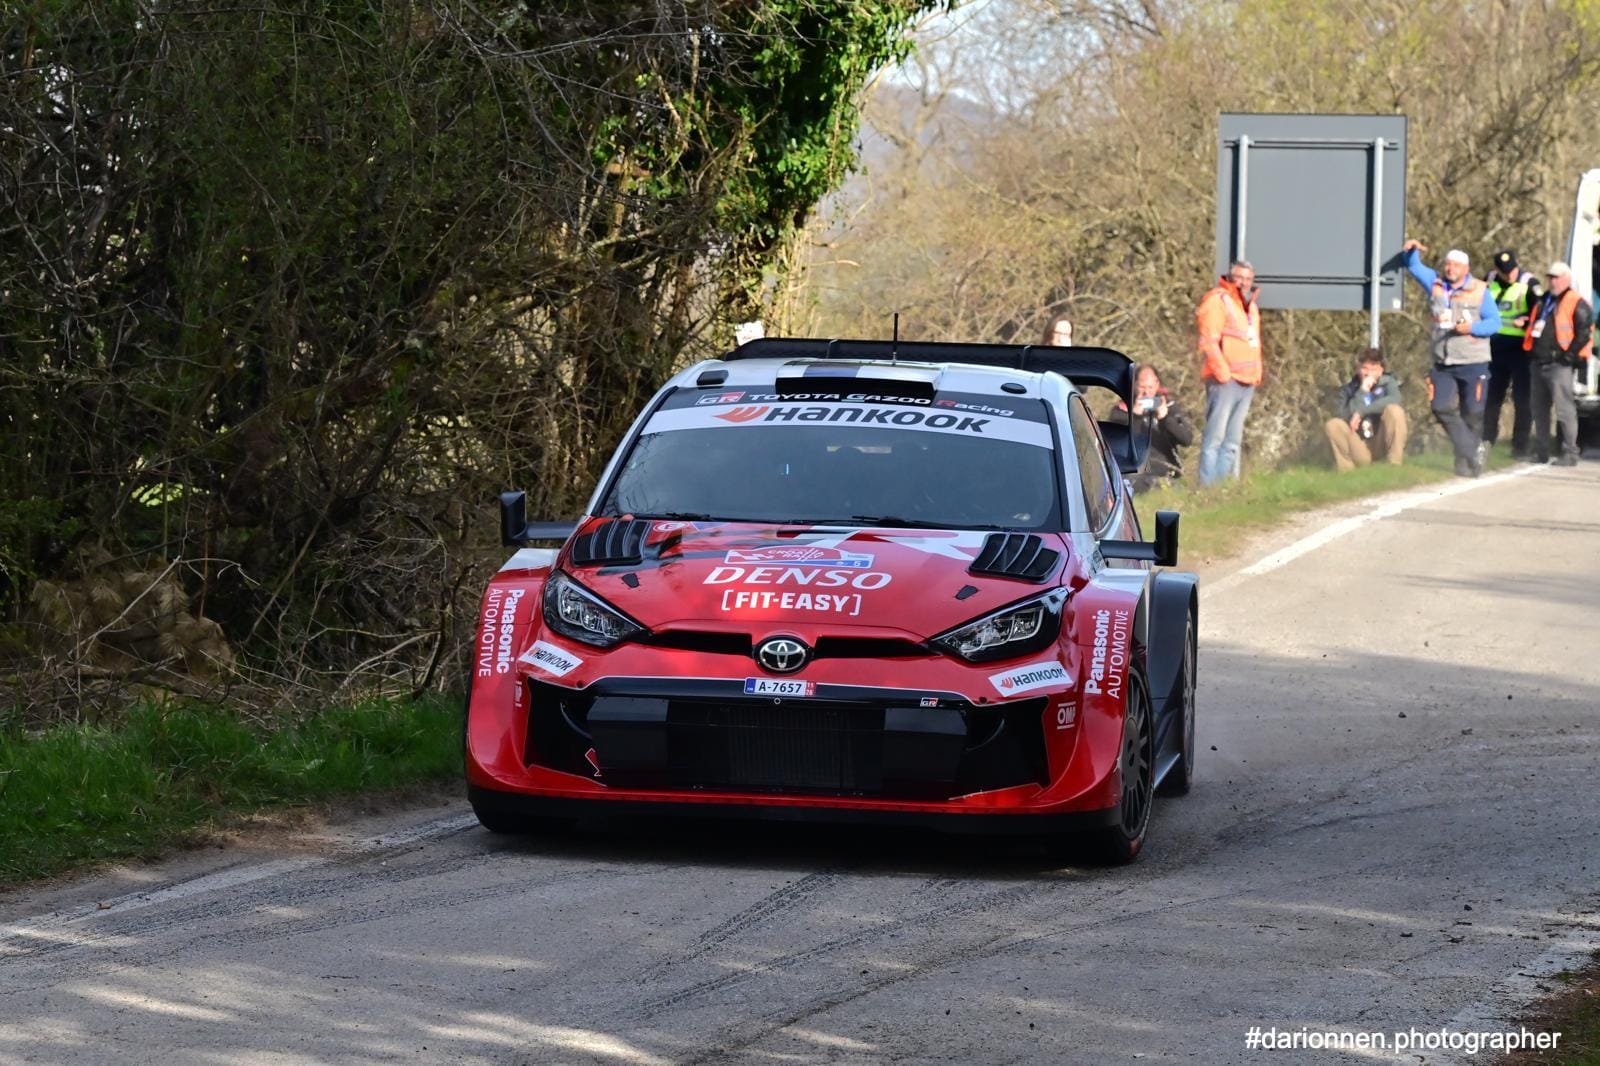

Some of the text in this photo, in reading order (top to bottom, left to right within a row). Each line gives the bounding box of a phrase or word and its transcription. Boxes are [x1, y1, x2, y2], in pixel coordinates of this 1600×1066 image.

[697, 393, 742, 404] GR
[847, 393, 931, 404] GAZOO
[935, 400, 1015, 416] Racing
[703, 567, 892, 589] DENSO
[478, 588, 504, 677] AUTOMOTIVE
[496, 589, 526, 674] Panasonic
[1084, 609, 1111, 695] Panasonic
[1106, 609, 1129, 699] AUTOMOTIVE
[758, 681, 802, 694] A-7657
